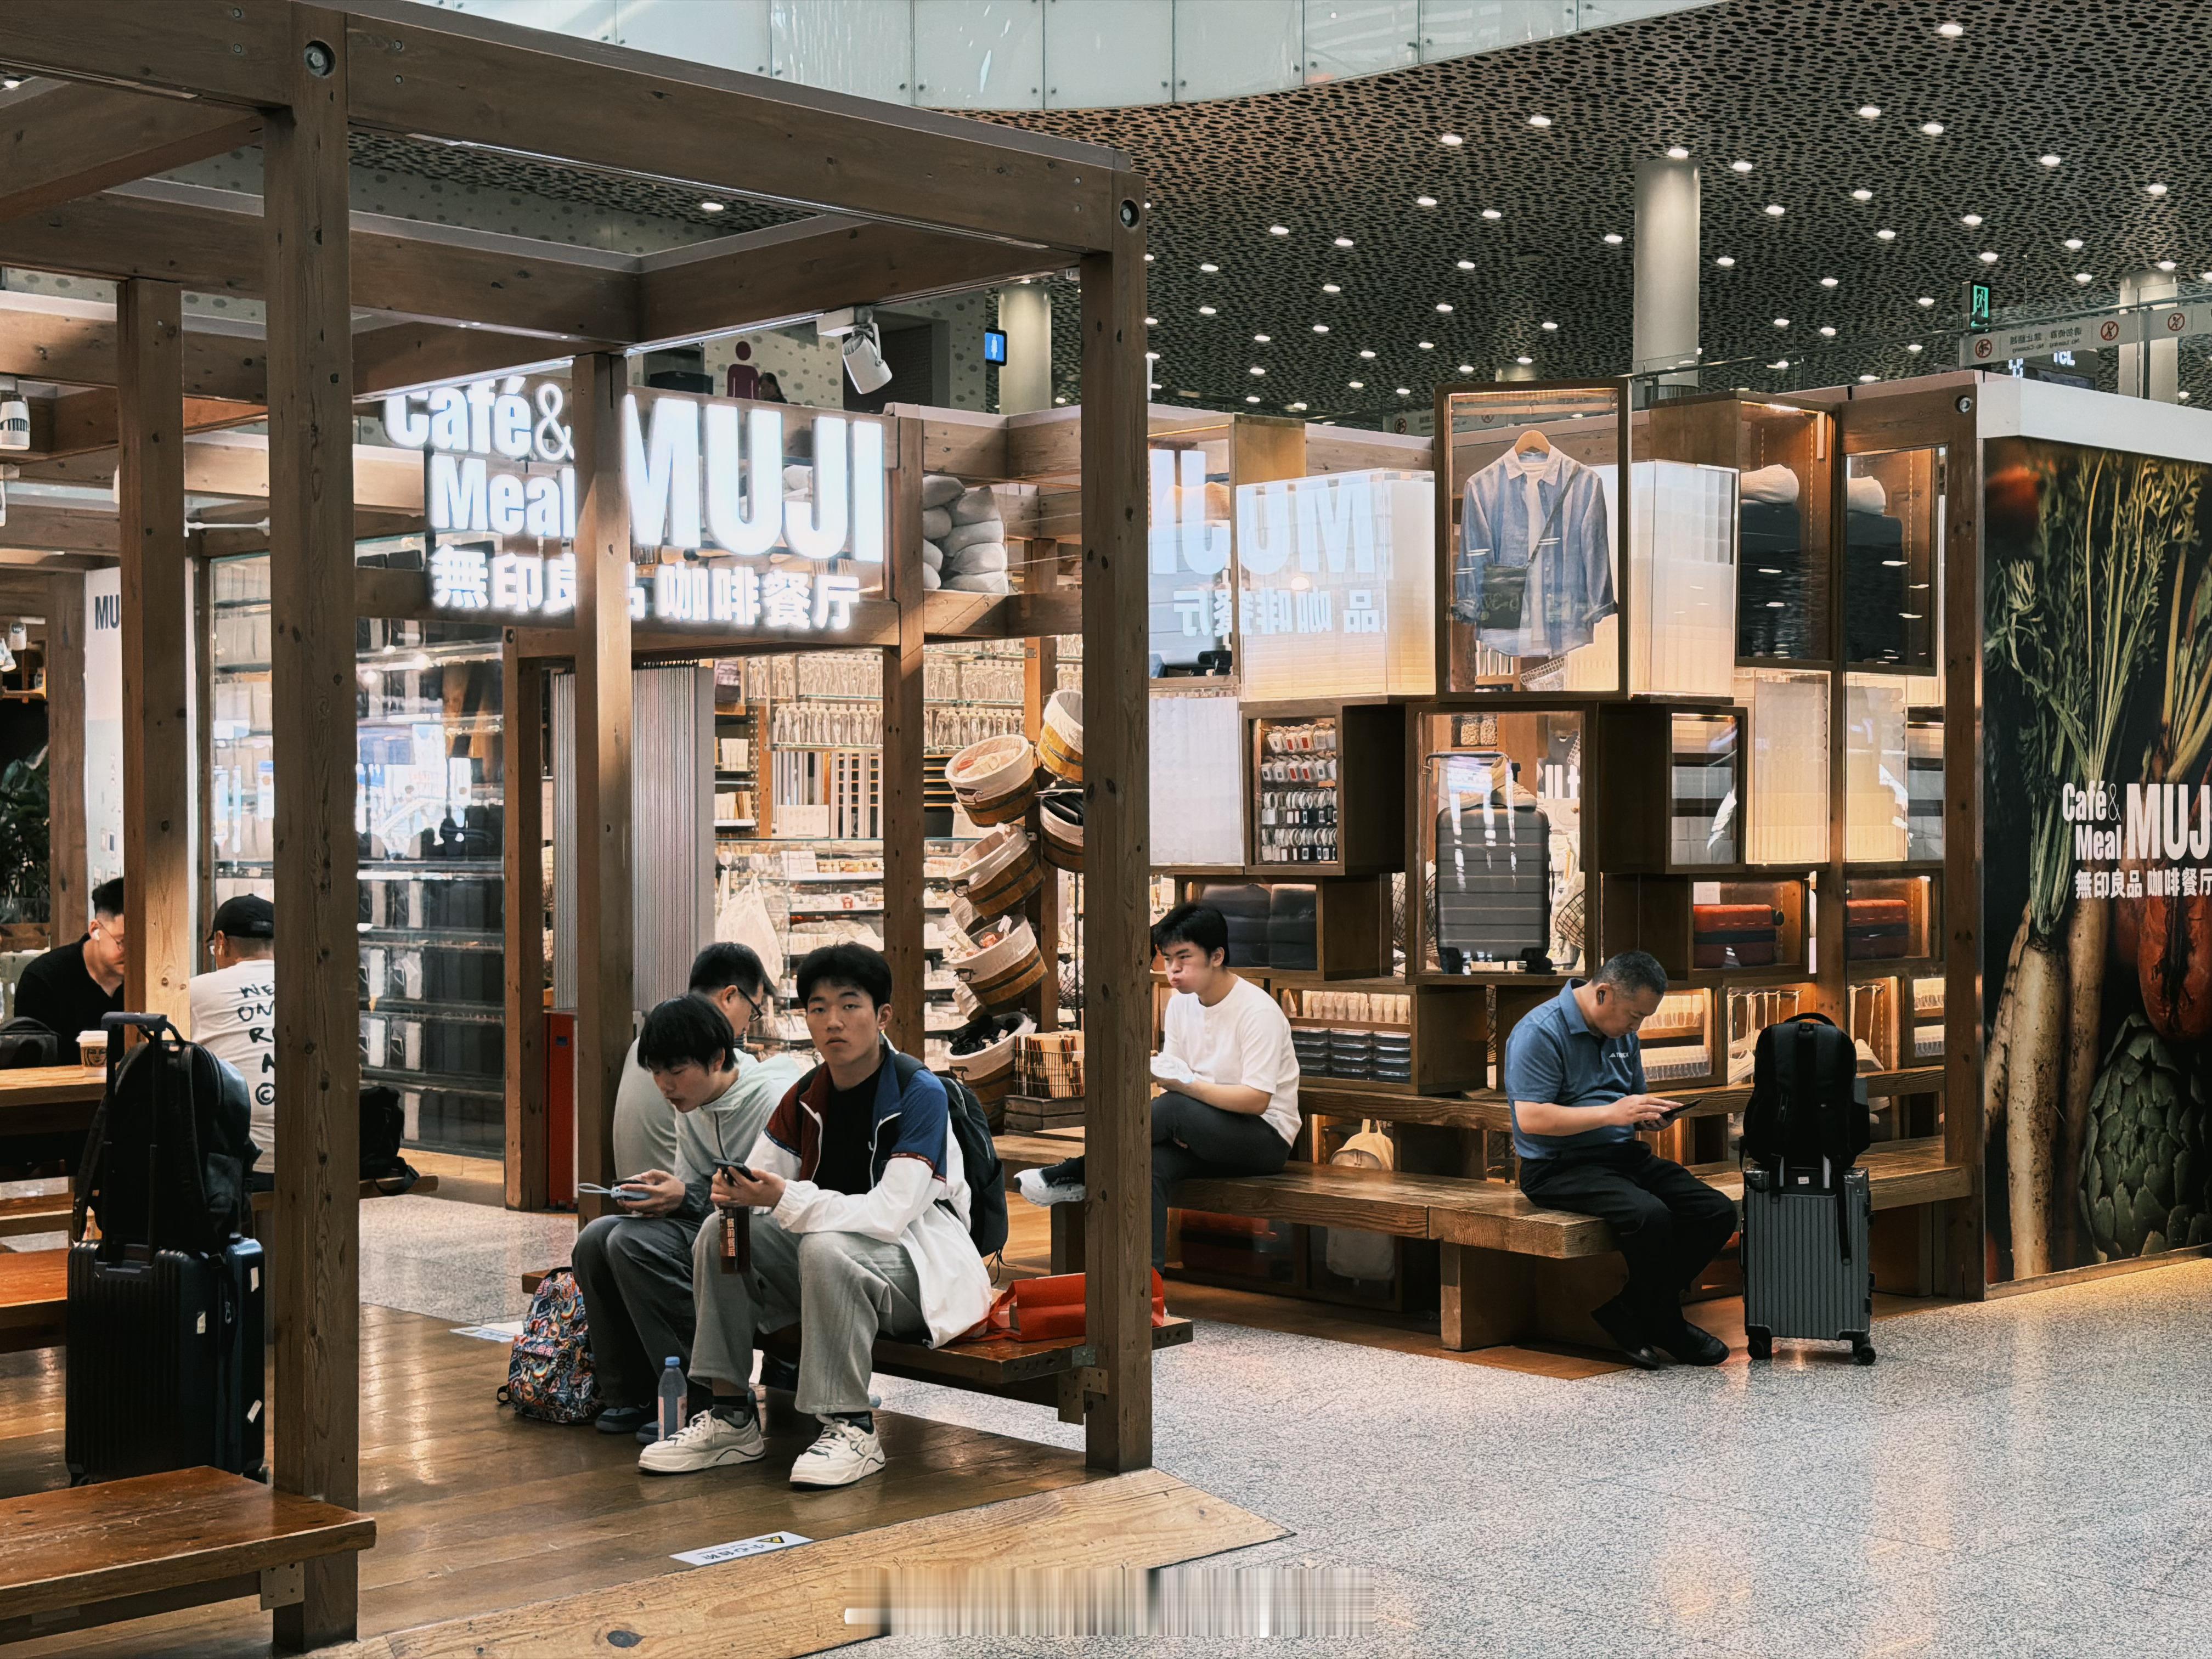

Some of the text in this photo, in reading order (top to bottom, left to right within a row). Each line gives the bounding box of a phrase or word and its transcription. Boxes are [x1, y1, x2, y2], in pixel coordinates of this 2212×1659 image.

[431, 454, 576, 538] Meal
[626, 393, 884, 562] MUJI
[2075, 824, 2122, 861] Meal
